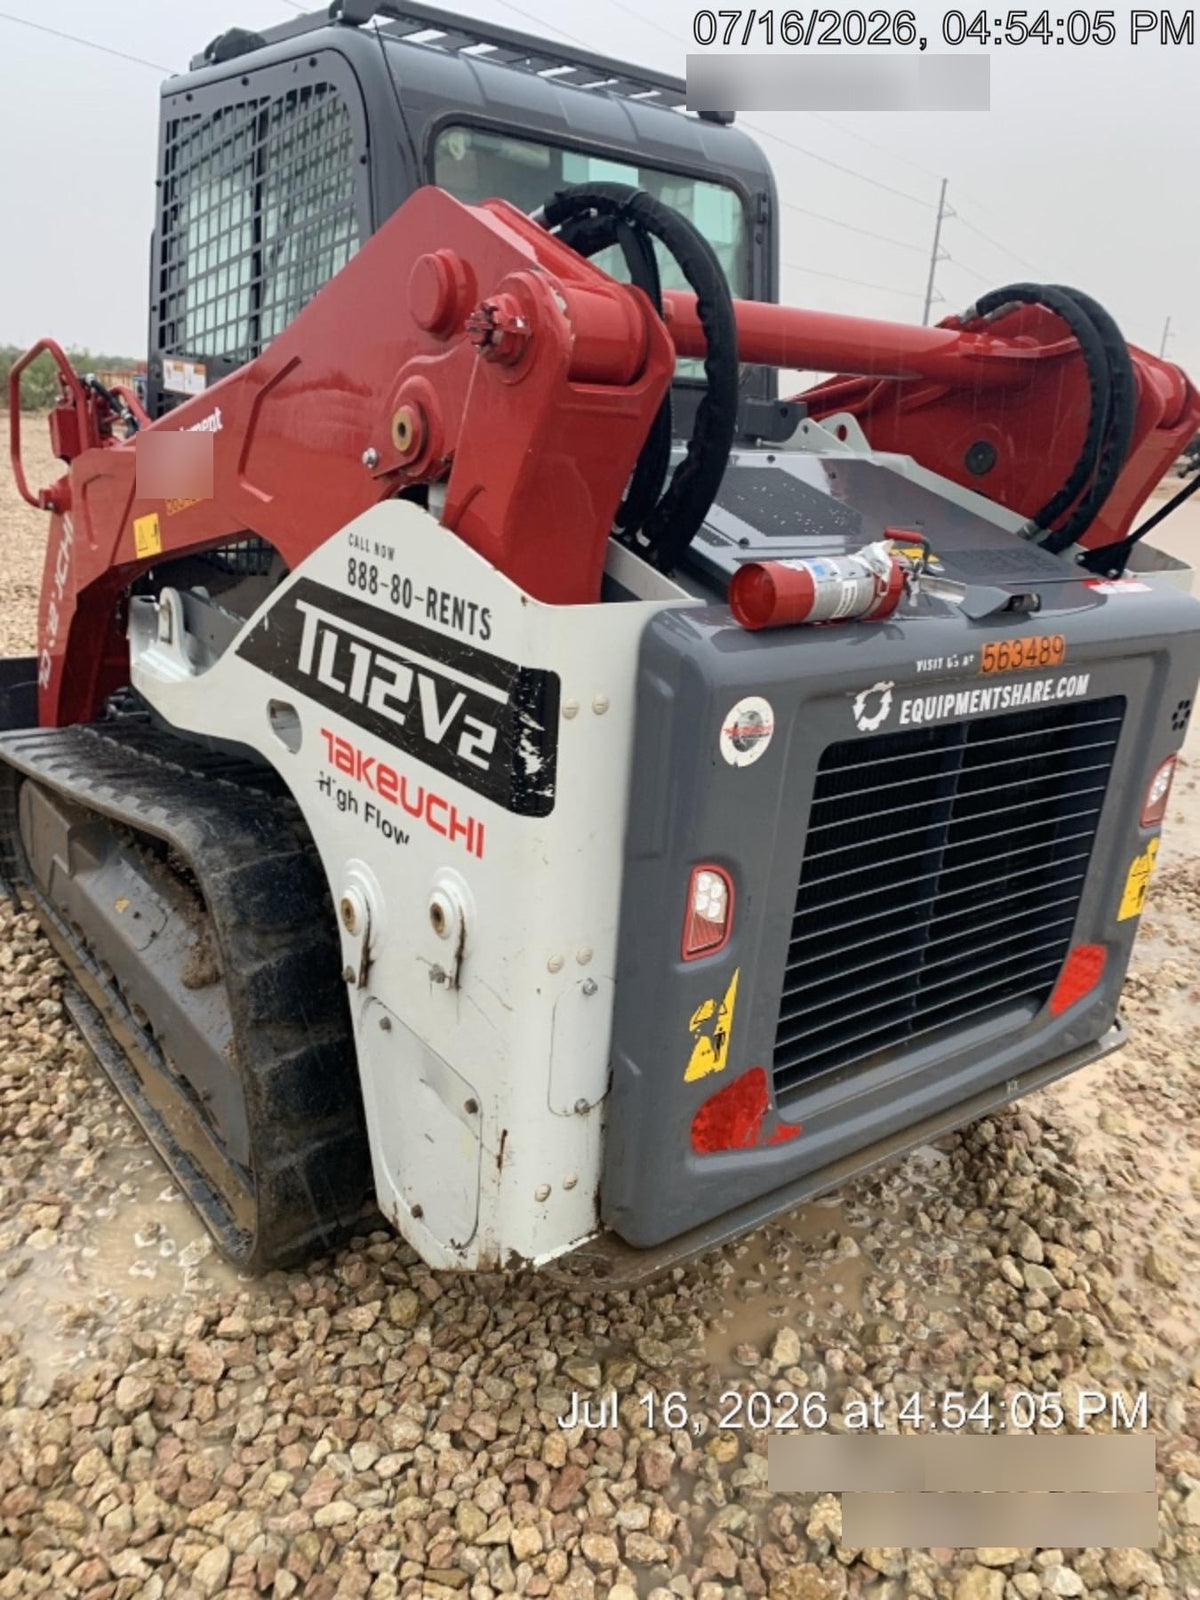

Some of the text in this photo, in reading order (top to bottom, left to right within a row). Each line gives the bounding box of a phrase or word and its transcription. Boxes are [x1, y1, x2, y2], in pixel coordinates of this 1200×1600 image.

[348, 533, 396, 562] CALL NOW
[347, 557, 492, 641] 888-80-RENTS
[916, 657, 943, 673] VISIT
[981, 635, 1066, 674] 563489
[295, 599, 511, 771] TL12V2
[899, 674, 1092, 725] EQUIPMENTSHARE.COM
[316, 770, 410, 846] Hgh Flow
